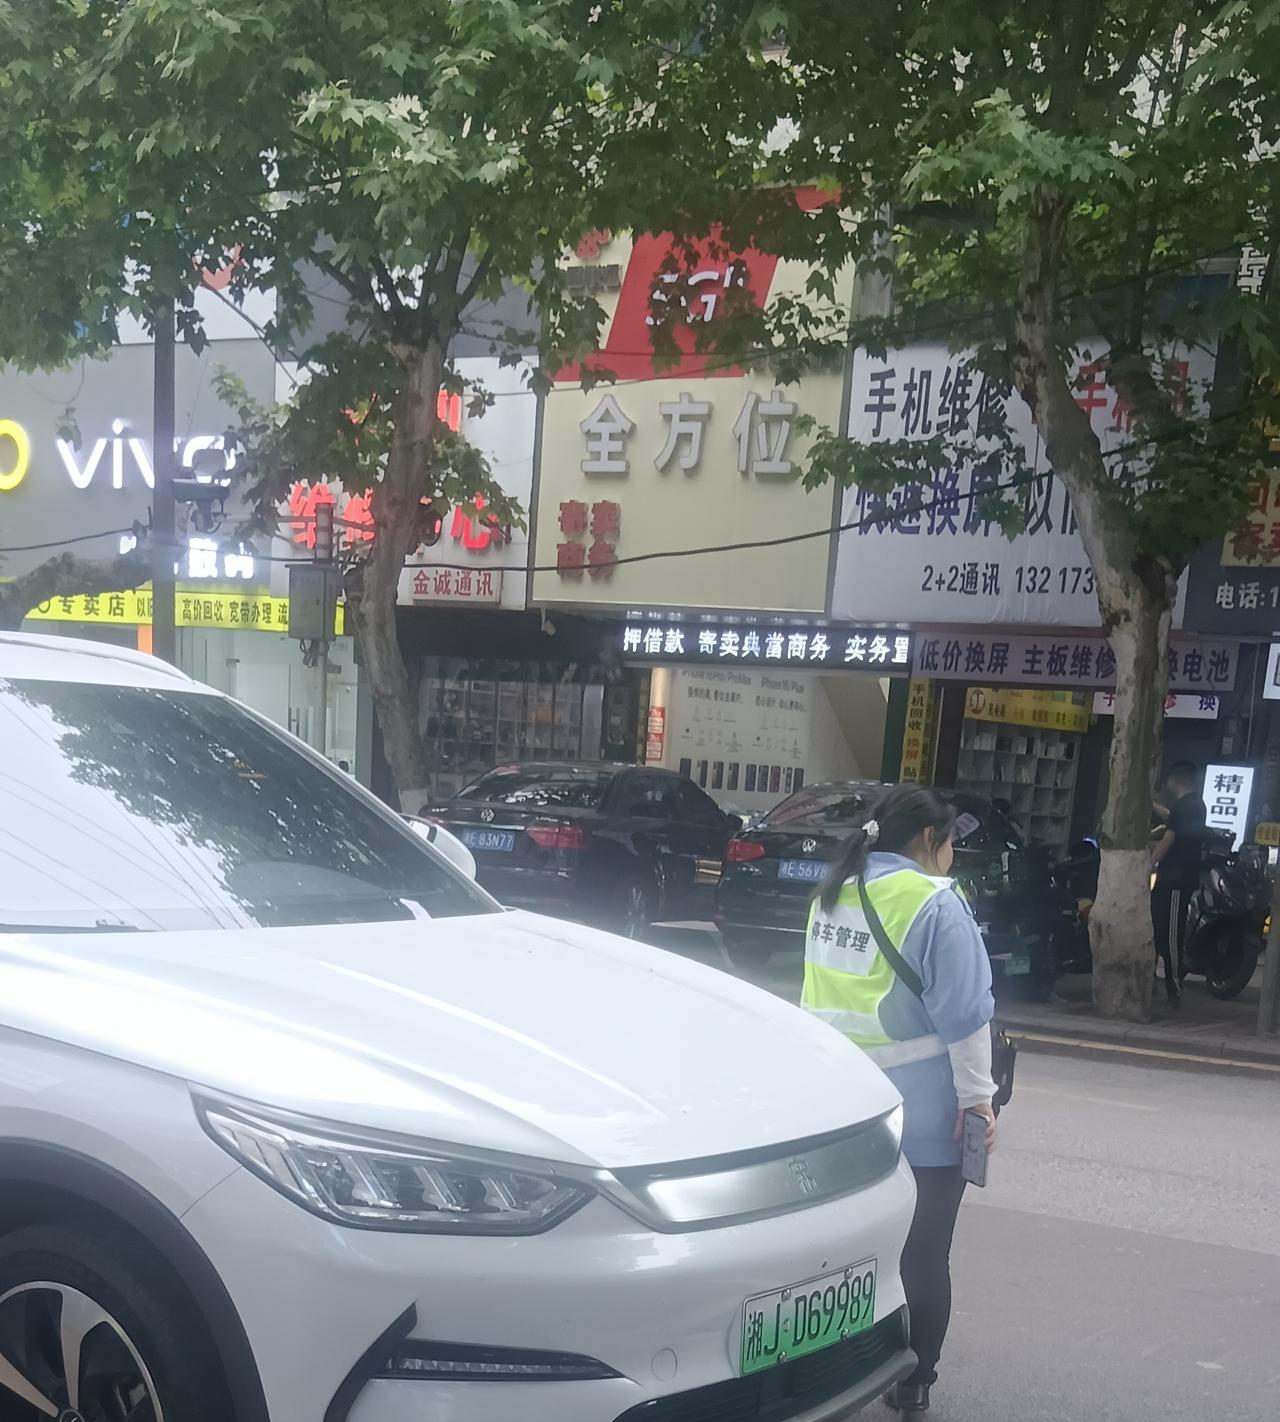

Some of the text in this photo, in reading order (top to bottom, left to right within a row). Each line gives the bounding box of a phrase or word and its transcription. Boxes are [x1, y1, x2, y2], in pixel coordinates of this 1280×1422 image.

[580, 390, 794, 474] 全方位
[413, 568, 493, 597] 金诚通讯
[921, 563, 1098, 595] 2+2通讯 132 173
[182, 598, 223, 622] 高价回收
[229, 600, 272, 625] 宽带办理
[623, 627, 684, 654] 押借款
[920, 639, 1010, 674] 低价换屏
[1022, 644, 1116, 678] 主板维修
[811, 920, 871, 953] 停车管理
